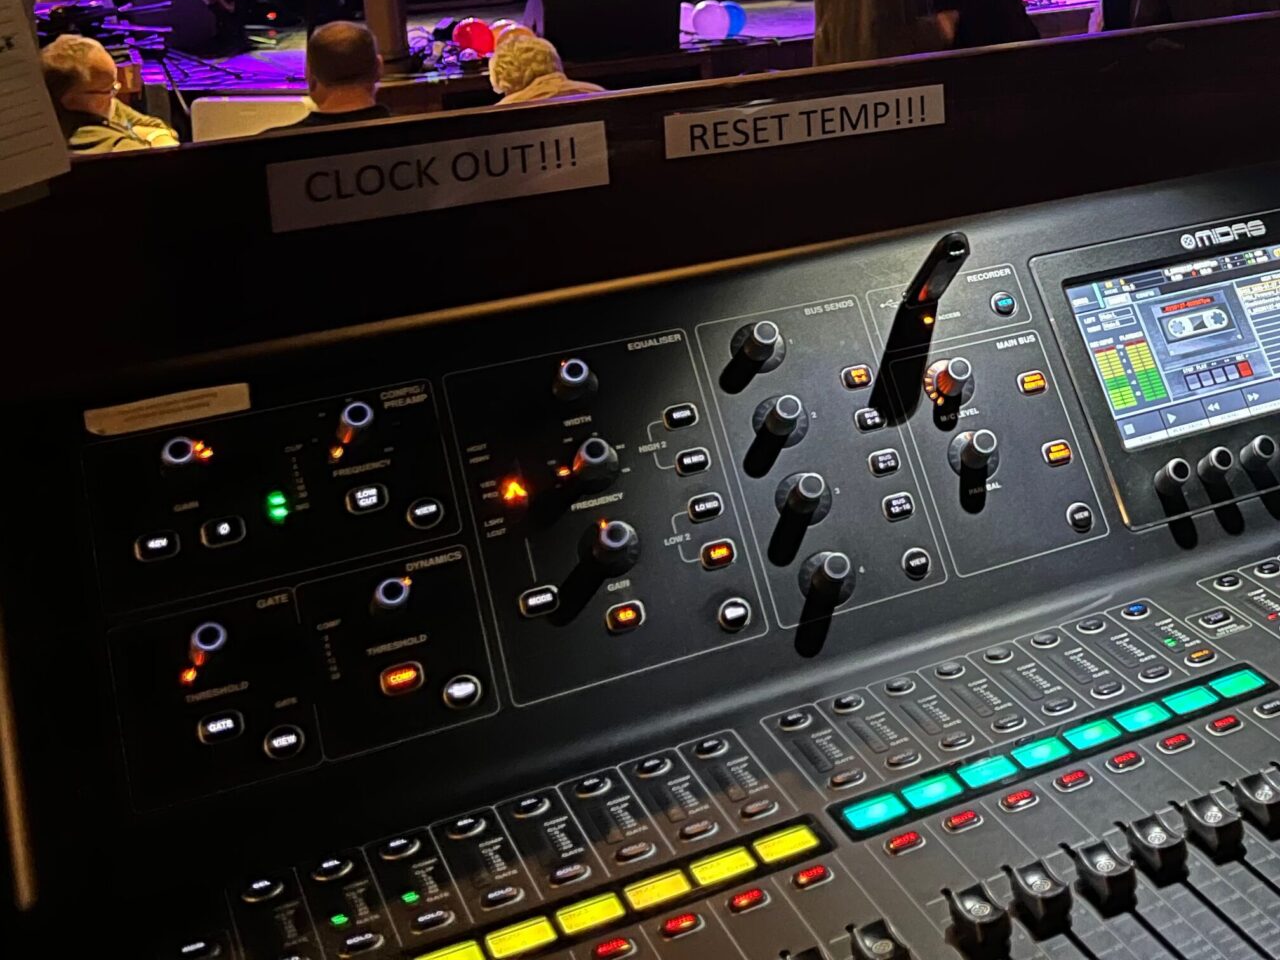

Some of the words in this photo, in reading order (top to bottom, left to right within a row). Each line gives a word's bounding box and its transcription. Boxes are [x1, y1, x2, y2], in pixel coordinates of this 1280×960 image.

[689, 113, 790, 152] RESET
[799, 95, 926, 137] TEMP!!!
[305, 156, 440, 203] CLOCK
[451, 137, 577, 182] OUT!!!
[1194, 219, 1267, 248] MIDAS
[966, 268, 1011, 283] RECORDER
[804, 306, 823, 316] BUS
[824, 300, 854, 312] SENDS
[627, 333, 682, 351] EQUALISER
[996, 338, 1018, 350] MAIN
[1018, 334, 1036, 346] BUS
[383, 393, 428, 409] PREAMP
[957, 407, 979, 418] LEVEL
[563, 415, 592, 427] WIDTH
[638, 442, 660, 453] HIGH
[332, 459, 391, 477] FREQUENCY
[356, 488, 377, 499] LOW
[358, 496, 378, 507] CUT
[570, 492, 624, 511] FREQUENCY
[664, 535, 684, 546] LOW
[405, 551, 462, 572] DYNAMICS
[909, 556, 927, 567] VIEW
[607, 579, 630, 592] GAIN
[256, 593, 289, 609] GATE
[366, 634, 428, 656] THRESHOLD
[185, 680, 249, 703] THRESHOLD
[206, 718, 234, 733] GATE
[272, 734, 297, 748] VIEW
